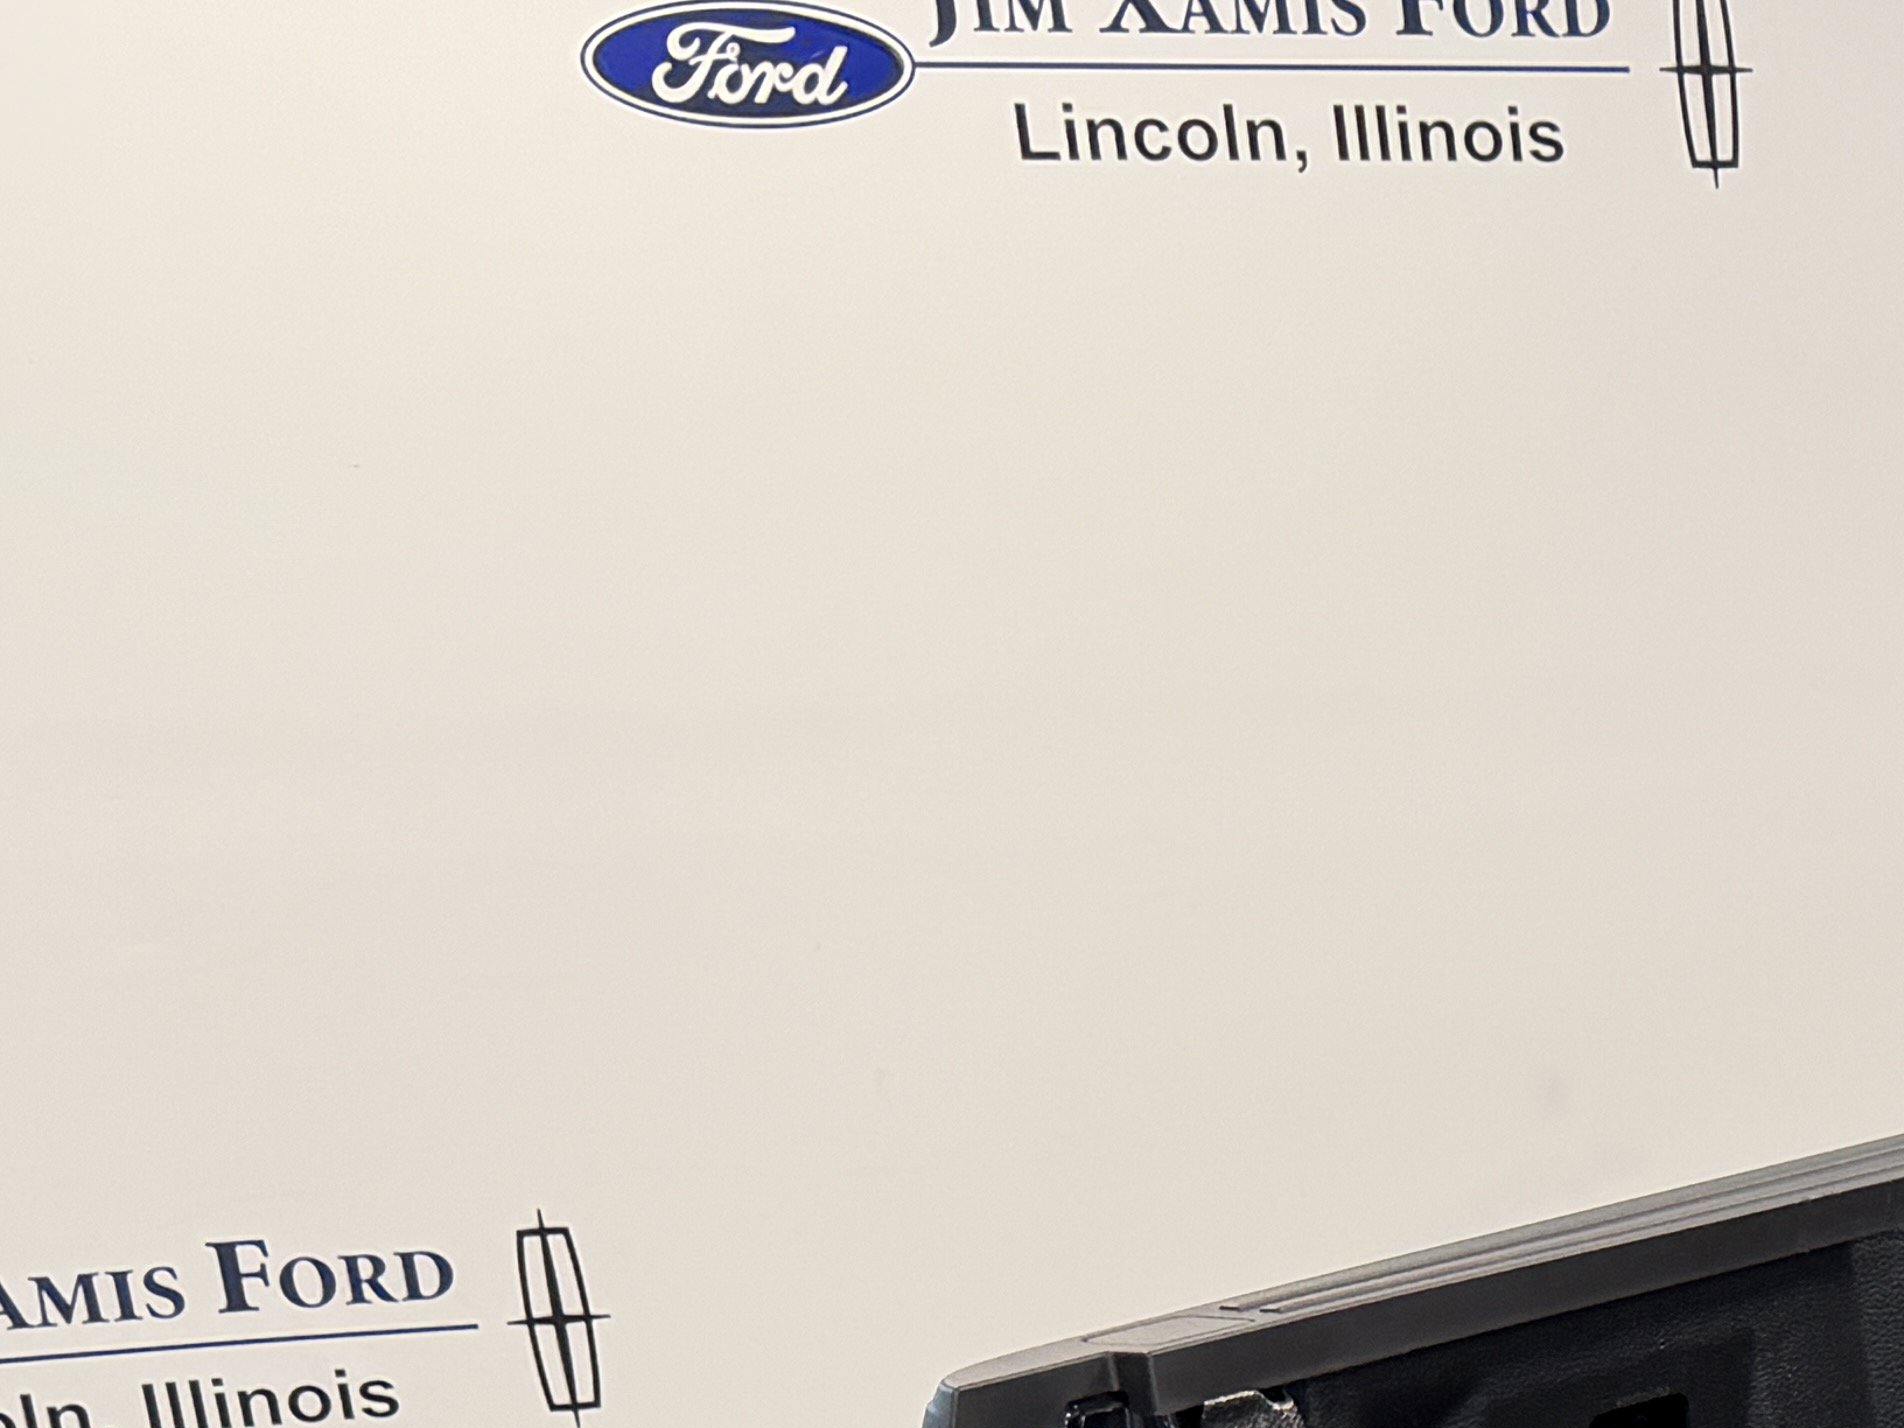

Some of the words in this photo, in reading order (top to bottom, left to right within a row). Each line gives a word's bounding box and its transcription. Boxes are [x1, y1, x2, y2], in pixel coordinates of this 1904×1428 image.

[652, 22, 848, 104] Ford
[1014, 102, 1308, 173] Lincoln,
[1334, 105, 1564, 163] Illinois
[205, 1240, 453, 1313] FORD
